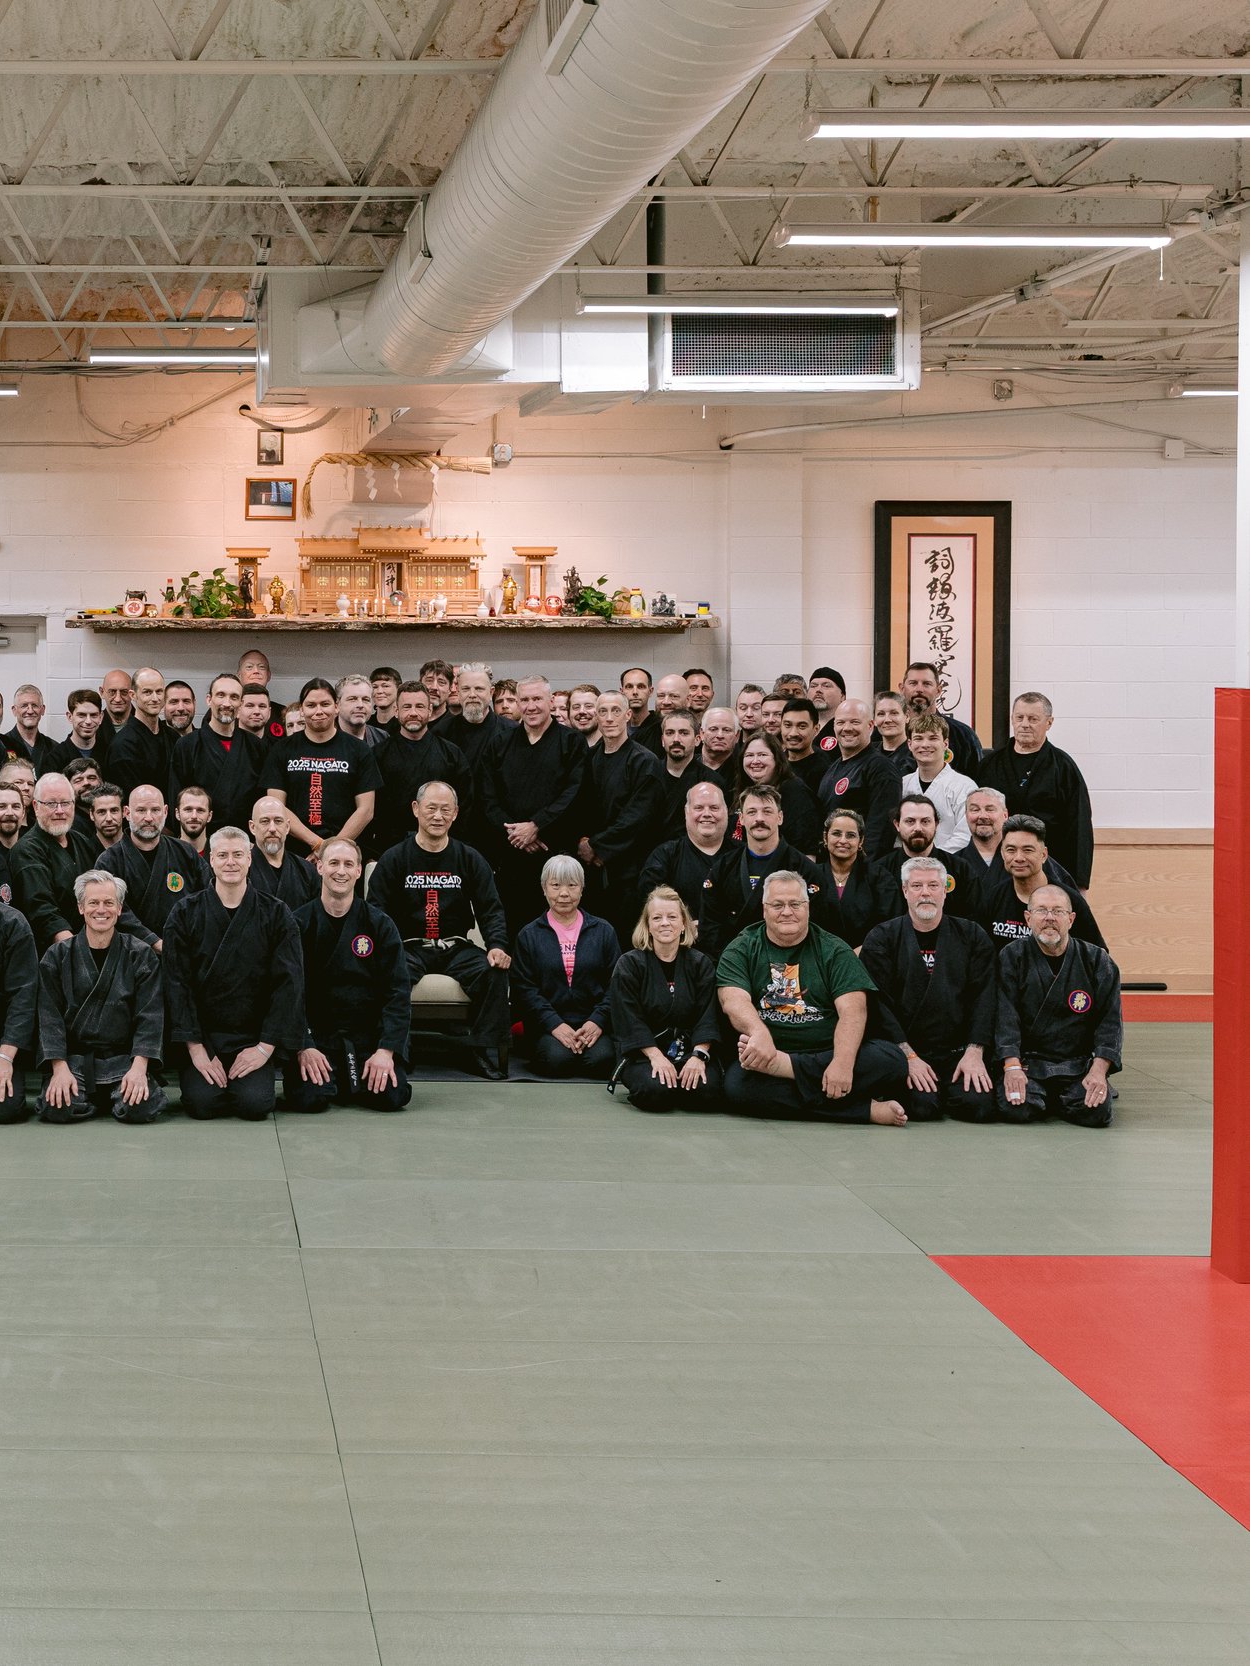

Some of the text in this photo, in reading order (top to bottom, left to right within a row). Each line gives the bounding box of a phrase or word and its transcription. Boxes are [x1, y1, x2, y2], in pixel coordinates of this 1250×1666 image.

[287, 759, 349, 770] 2025 NAGATO
[309, 772, 322, 825] 自然至極
[405, 874, 462, 885] 025 NAGATO
[992, 921, 1017, 934] 2025
